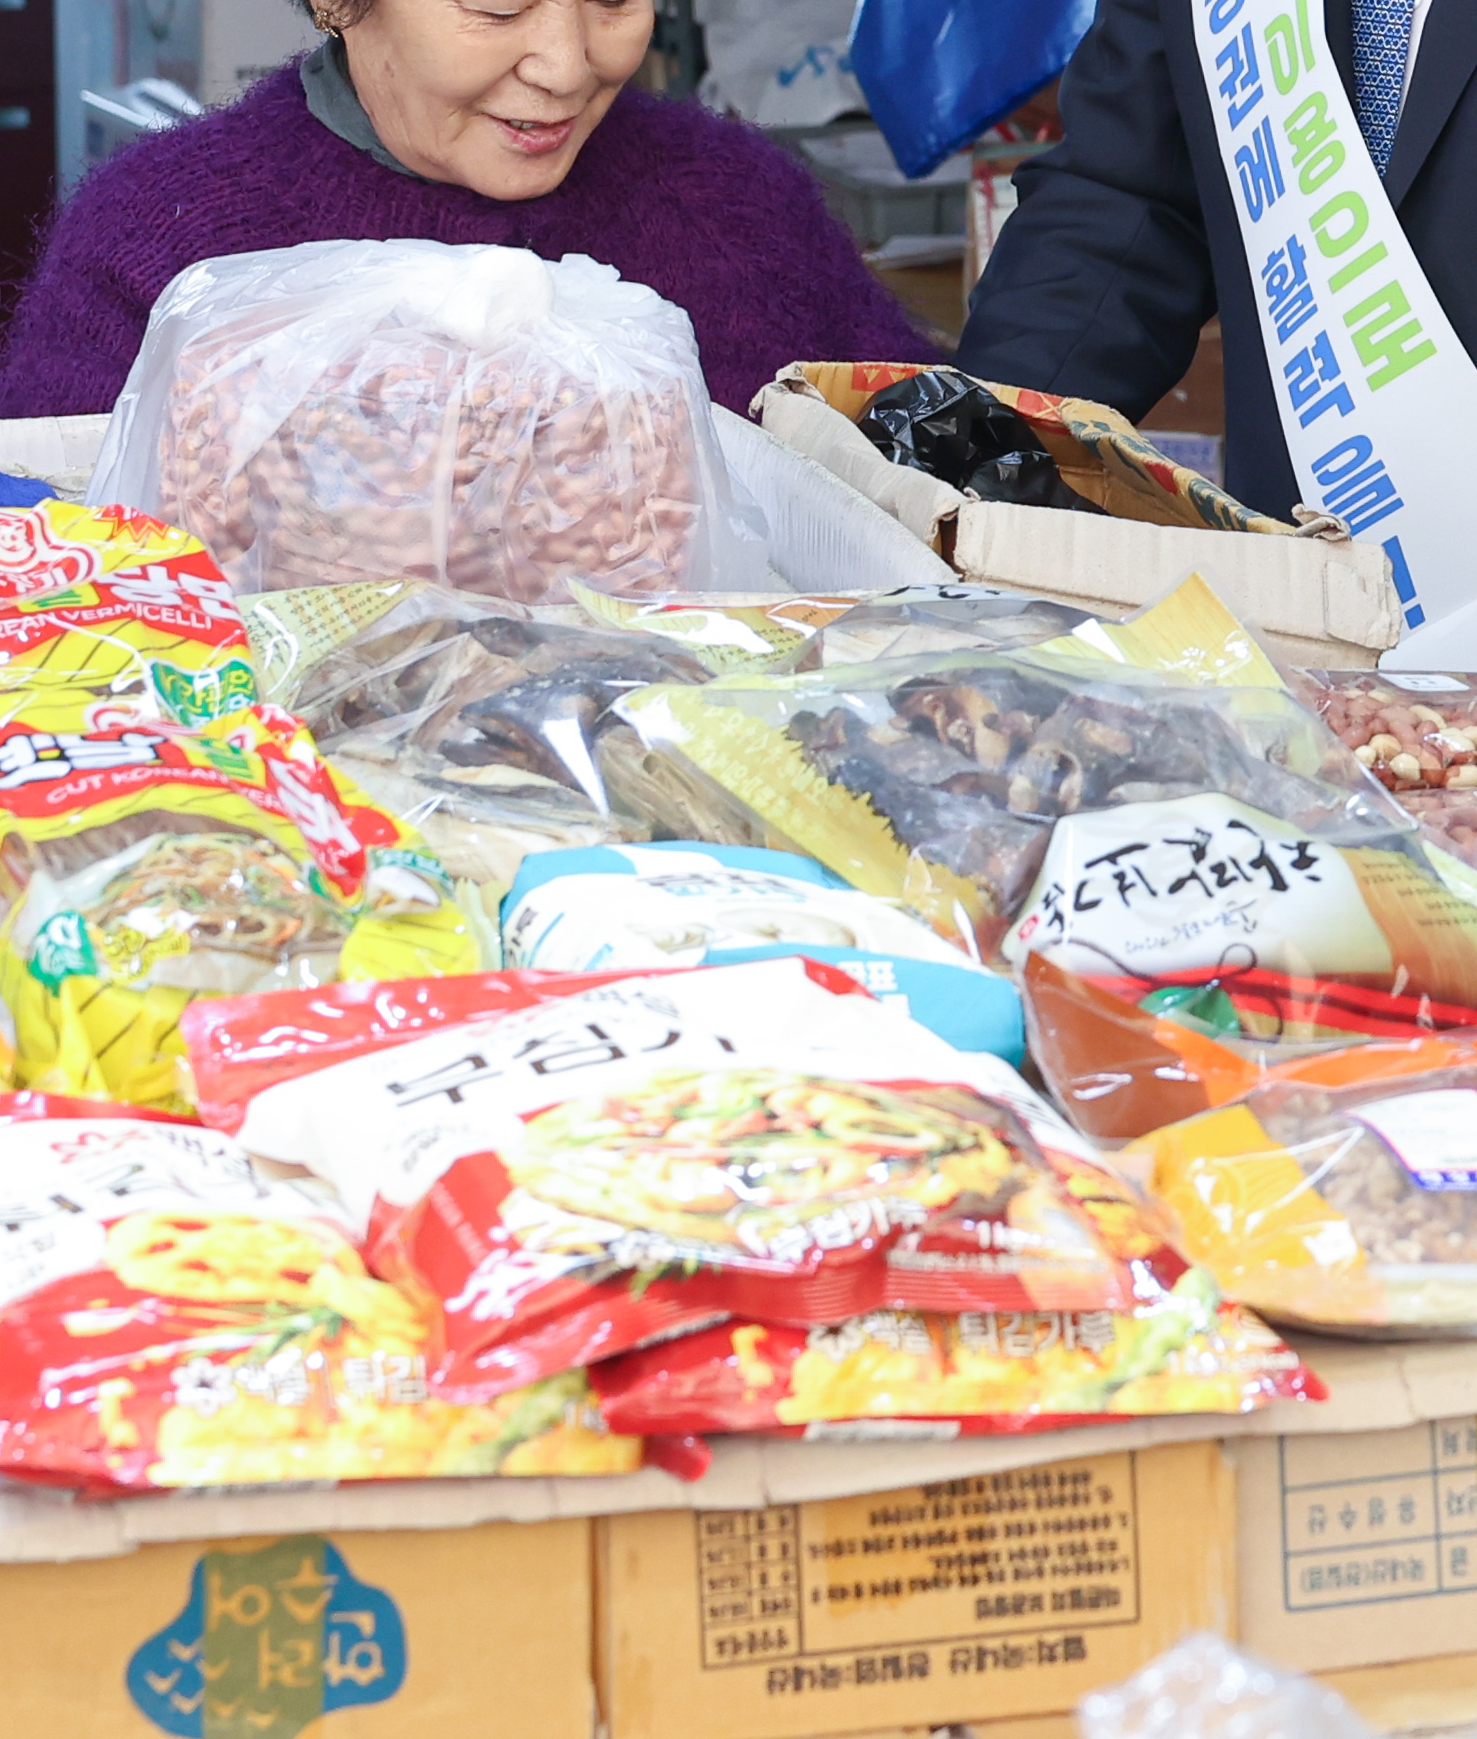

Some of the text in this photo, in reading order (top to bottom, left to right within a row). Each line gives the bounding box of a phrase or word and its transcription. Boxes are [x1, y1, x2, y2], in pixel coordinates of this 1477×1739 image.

[1260, 233, 1427, 630] 활력을!
[65, 604, 213, 631] VERMICELLI
[958, 1311, 1114, 1353] 튀김가루
[207, 1556, 339, 1630] 수어
[256, 1611, 386, 1691] 한려
